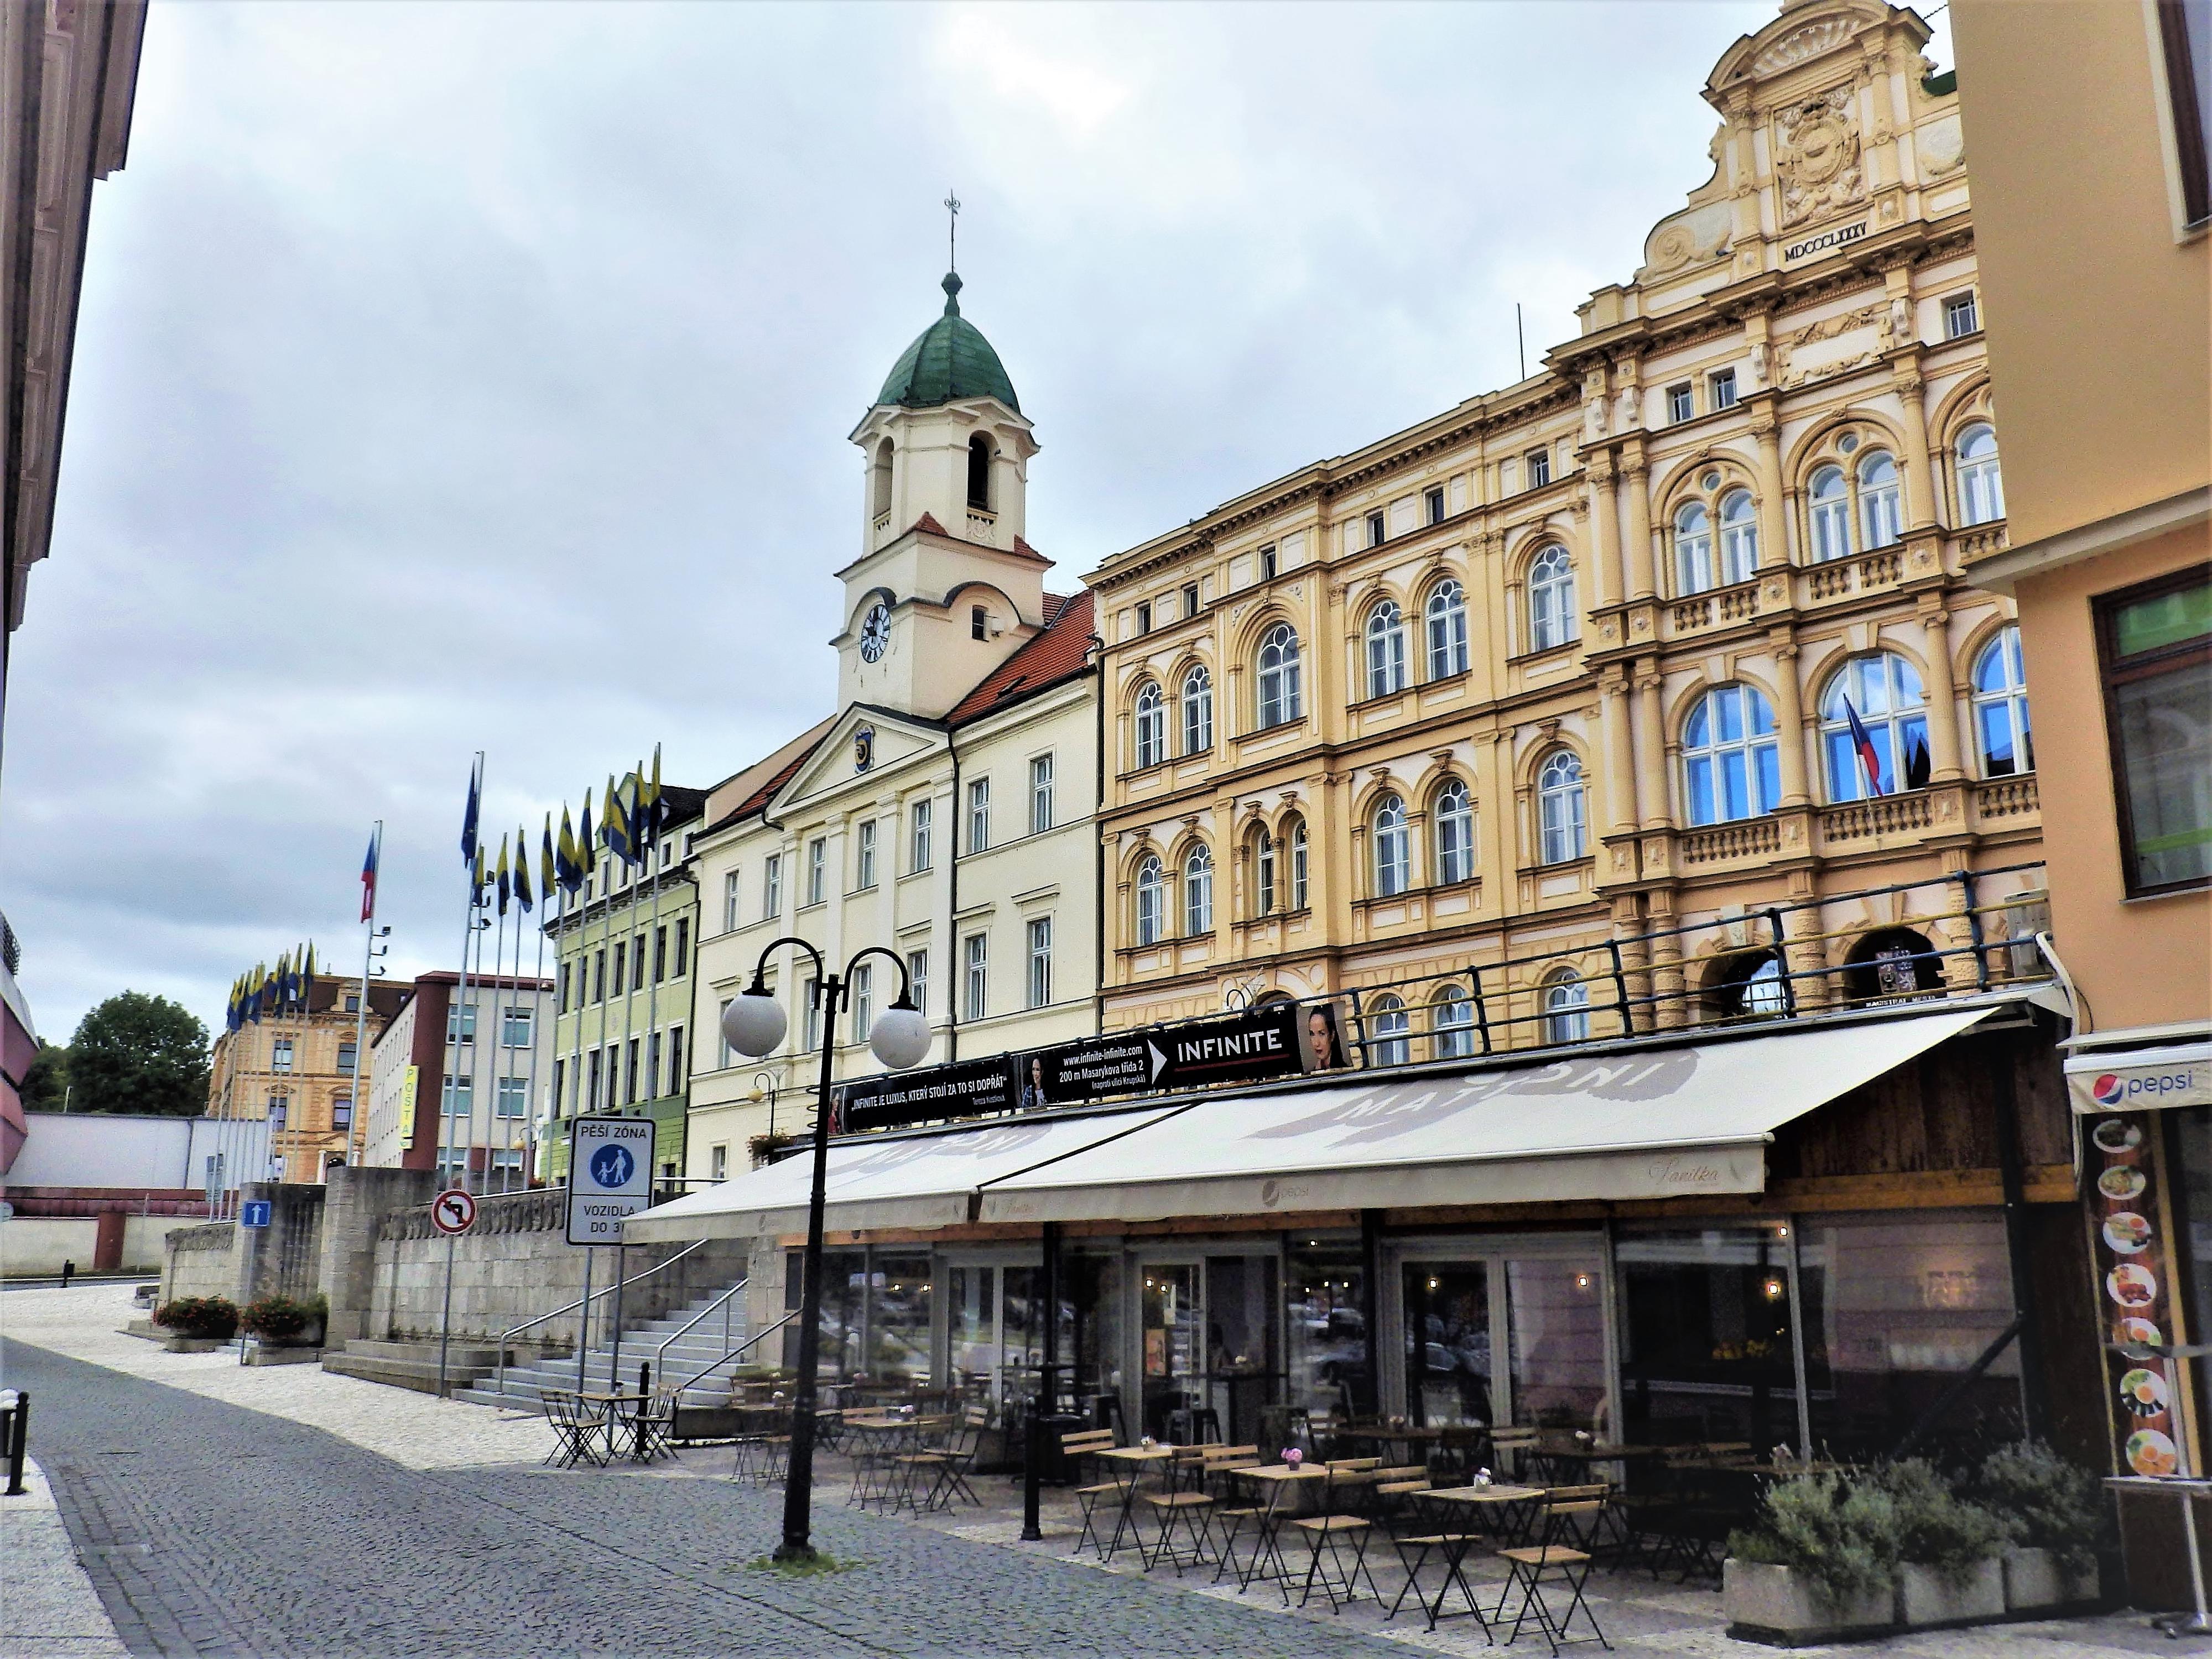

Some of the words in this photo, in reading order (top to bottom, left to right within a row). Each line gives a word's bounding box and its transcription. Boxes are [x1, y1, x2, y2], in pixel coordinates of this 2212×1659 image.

[1784, 221, 1867, 262] MDCCCLXXXV
[1063, 1046, 1142, 1066] www.infinite-infinite.com
[1178, 1028, 1282, 1062] INFINITE
[1059, 1071, 1073, 1083] 200
[1074, 1071, 1080, 1080] m
[1082, 1065, 1120, 1079] Masarykova
[1121, 1061, 1137, 1073] třída
[1138, 1060, 1144, 1071] 2
[878, 1095, 886, 1107] JE
[886, 1091, 908, 1105] LUXUS,
[908, 1084, 928, 1102] KTERÝ
[929, 1082, 946, 1098] STOJÍ
[948, 1083, 956, 1095] ZA
[957, 1082, 967, 1093] TO
[968, 1081, 975, 1092] SI
[2128, 1070, 2194, 1098] pepsi
[581, 1124, 609, 1138] PĚŠÍ
[614, 1125, 647, 1139] ZÓNA
[584, 1206, 635, 1217] VOZIDLA
[591, 1222, 607, 1233] DO
